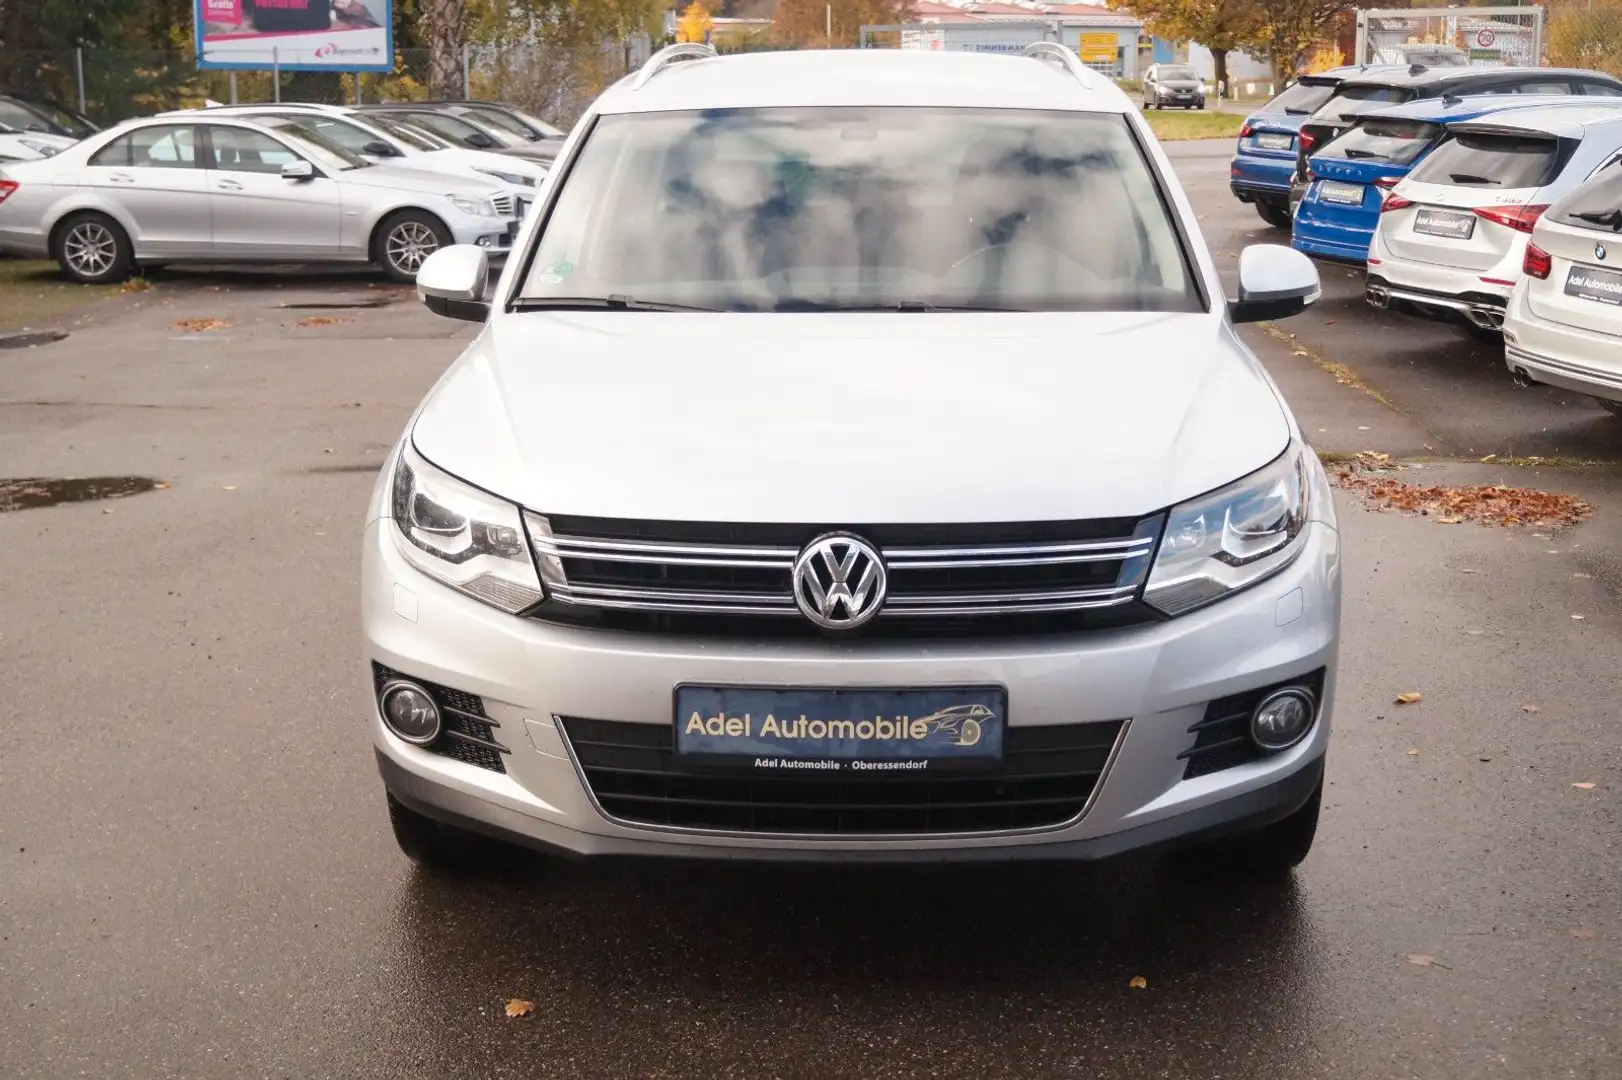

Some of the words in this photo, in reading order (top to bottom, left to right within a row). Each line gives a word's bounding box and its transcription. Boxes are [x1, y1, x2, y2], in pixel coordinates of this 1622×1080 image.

[1568, 275, 1584, 286] Adel
[685, 711, 751, 737] Adel
[759, 713, 928, 740] Automobile
[754, 758, 778, 768] Adel
[780, 759, 840, 769] Automobile
[852, 760, 928, 770] Oberessendorf
